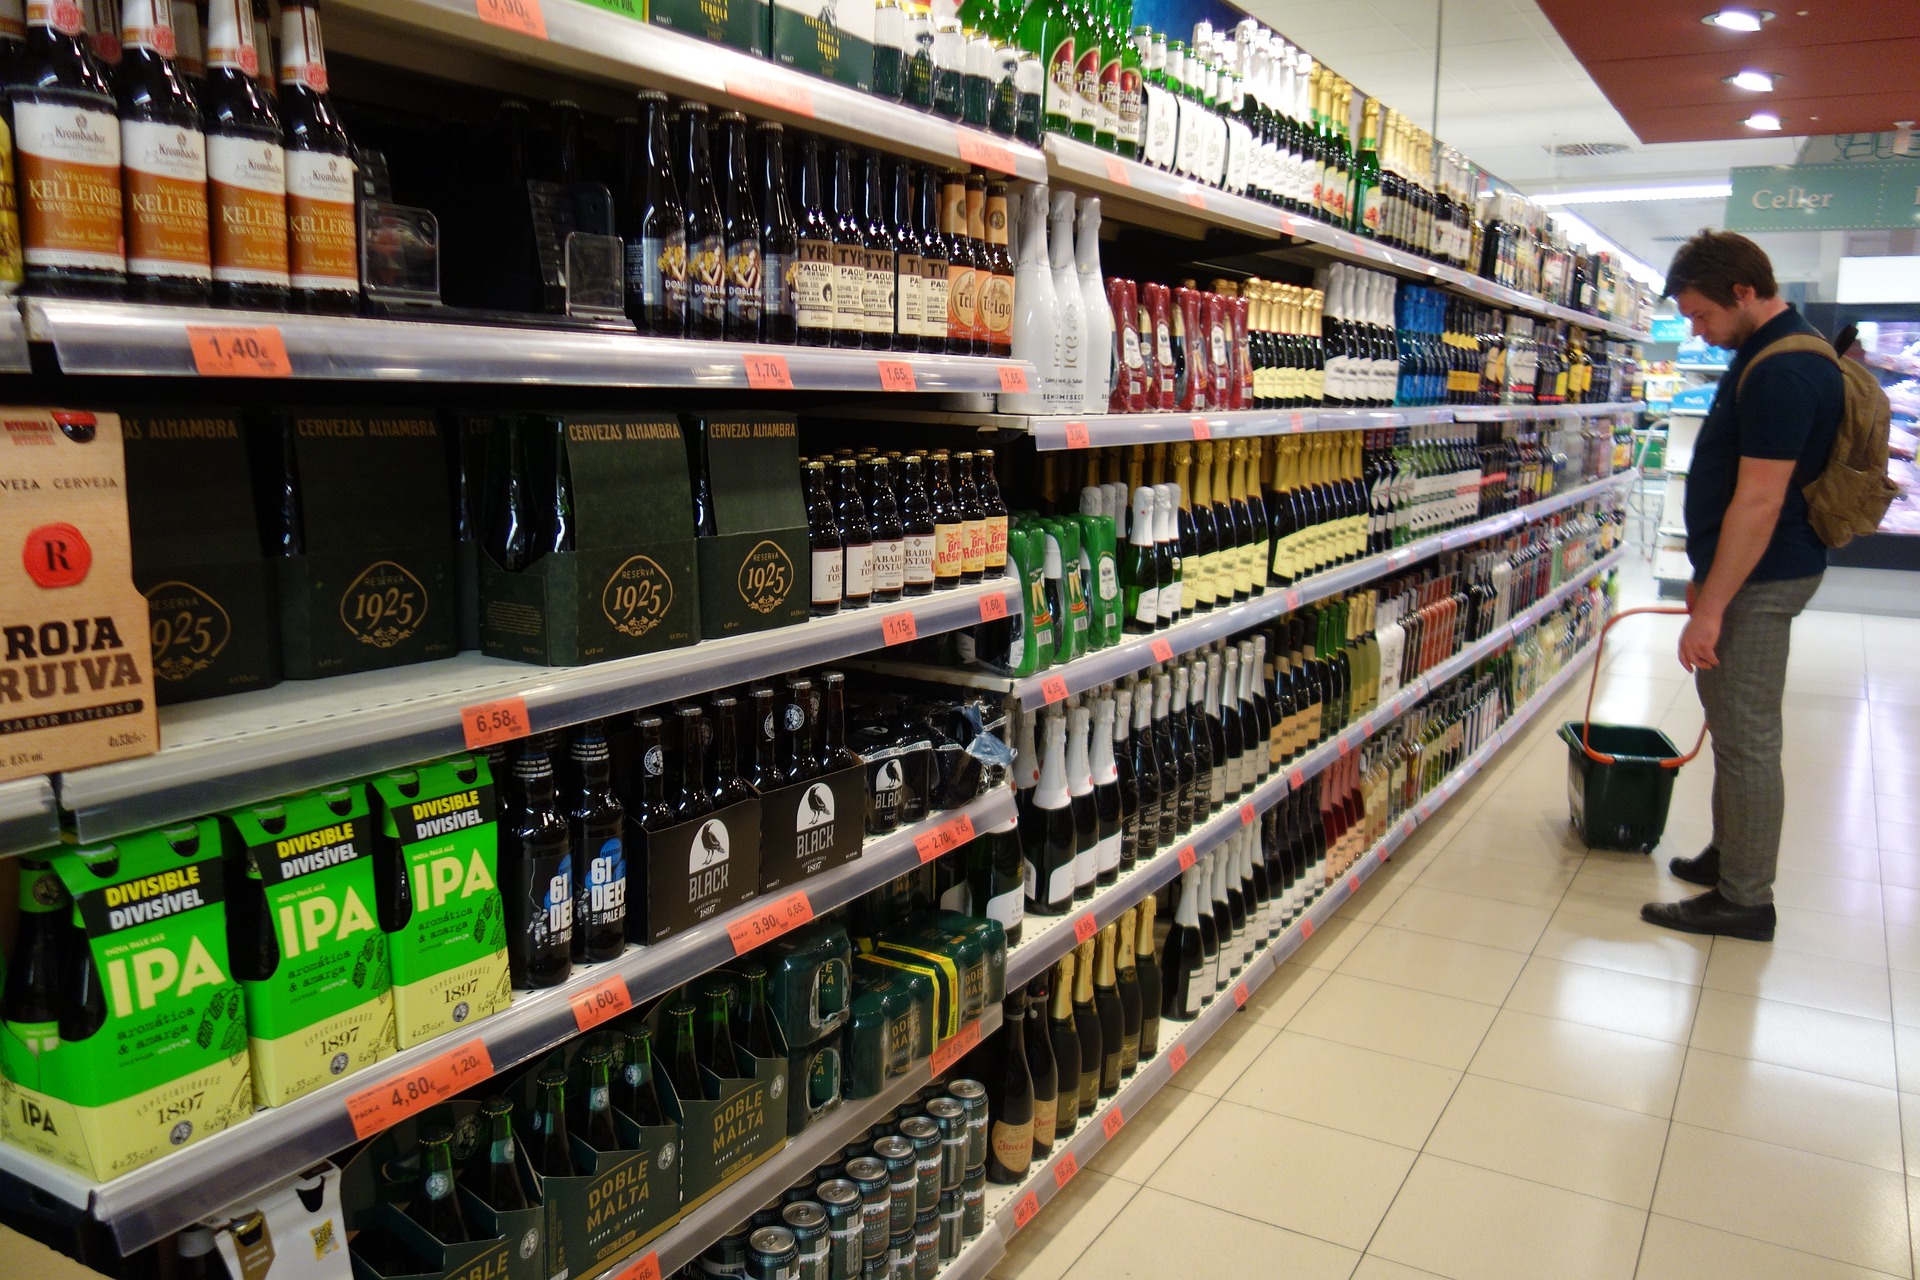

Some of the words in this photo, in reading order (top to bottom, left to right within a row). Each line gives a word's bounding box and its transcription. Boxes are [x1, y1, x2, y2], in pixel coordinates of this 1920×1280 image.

[817, 40, 840, 60] TEQUILA
[1752, 187, 1833, 210] Celler
[694, 284, 718, 293] DOBLE
[729, 286, 753, 296] DOBLE
[209, 335, 269, 360] 1,40€
[754, 363, 782, 378] 1,70€
[886, 367, 909, 381] 1,65€
[1005, 373, 1022, 388] 1,65€
[151, 419, 238, 439] ALHAMBRA
[297, 419, 364, 437] CERVEZAS
[369, 419, 437, 437] ALHAMBRA
[568, 424, 623, 442] CERVEZAS
[626, 423, 681, 439] ALHAMBRA
[710, 423, 750, 438] CERVEZAS
[753, 423, 796, 437] ALHAMBRA
[53, 477, 118, 490] CERVEJA
[44, 540, 71, 572] R
[753, 552, 779, 562] RESERVA
[364, 574, 405, 586] RESERVA
[621, 568, 655, 580] RESERVA
[746, 562, 785, 598] 1925
[354, 587, 415, 630] 1925
[612, 580, 662, 620] 1925
[984, 598, 1001, 612] 1,60€
[3, 616, 124, 662] ROJA
[151, 610, 212, 660] 925
[889, 619, 910, 636] 1,15€
[0, 652, 142, 704] RUIVA
[1047, 682, 1063, 695] 4,35€
[3, 716, 60, 732] SABOR
[67, 702, 135, 723] INTENSO
[476, 708, 518, 734] 6,58€
[412, 790, 480, 820] DIVISIBLE
[416, 808, 484, 840] DIVISÍVEL
[932, 832, 951, 849] 2,70€
[956, 824, 969, 835] 0,45€
[276, 823, 355, 859] DIVISIBLE
[796, 824, 834, 859] BLACK
[280, 843, 358, 880] DIVISÍVEL
[591, 856, 612, 884] 61
[806, 860, 822, 873] 1897
[105, 865, 200, 908] DIVISIBLE
[413, 848, 496, 913] IPA
[550, 872, 568, 903] 61
[592, 877, 625, 912] DEEP
[688, 863, 729, 903] BLACK
[109, 888, 204, 931] DIVISÍVEL
[279, 885, 377, 959] IPA
[418, 905, 473, 931] aromática
[603, 908, 618, 925] PALE
[699, 904, 716, 918] 1897
[752, 914, 780, 935] 3,90€
[786, 903, 805, 917] 0,65€
[418, 933, 426, 943] &
[429, 919, 468, 939] amarga
[1078, 920, 1094, 936] 8,95€
[107, 935, 227, 1019] IPA
[288, 948, 352, 980] aromática
[288, 981, 297, 993] &
[302, 964, 346, 989] amarga
[965, 967, 984, 985] DOB
[444, 978, 479, 1004] 1897
[584, 989, 619, 1015] 1,60€
[117, 1006, 195, 1041] aromática
[118, 1044, 129, 1056] &
[136, 1024, 189, 1049] amarga
[319, 1027, 360, 1056] 1897
[392, 1076, 435, 1107] 4,80€
[451, 1055, 482, 1077] 1,20€
[20, 1098, 58, 1136] IPA
[157, 1092, 205, 1126] 1897
[714, 1089, 763, 1132] DOBLE
[711, 1108, 764, 1154] MALTA
[588, 1158, 648, 1210] DOBLE
[1058, 1160, 1074, 1179] 16,25€
[586, 1181, 649, 1232] MALTA
